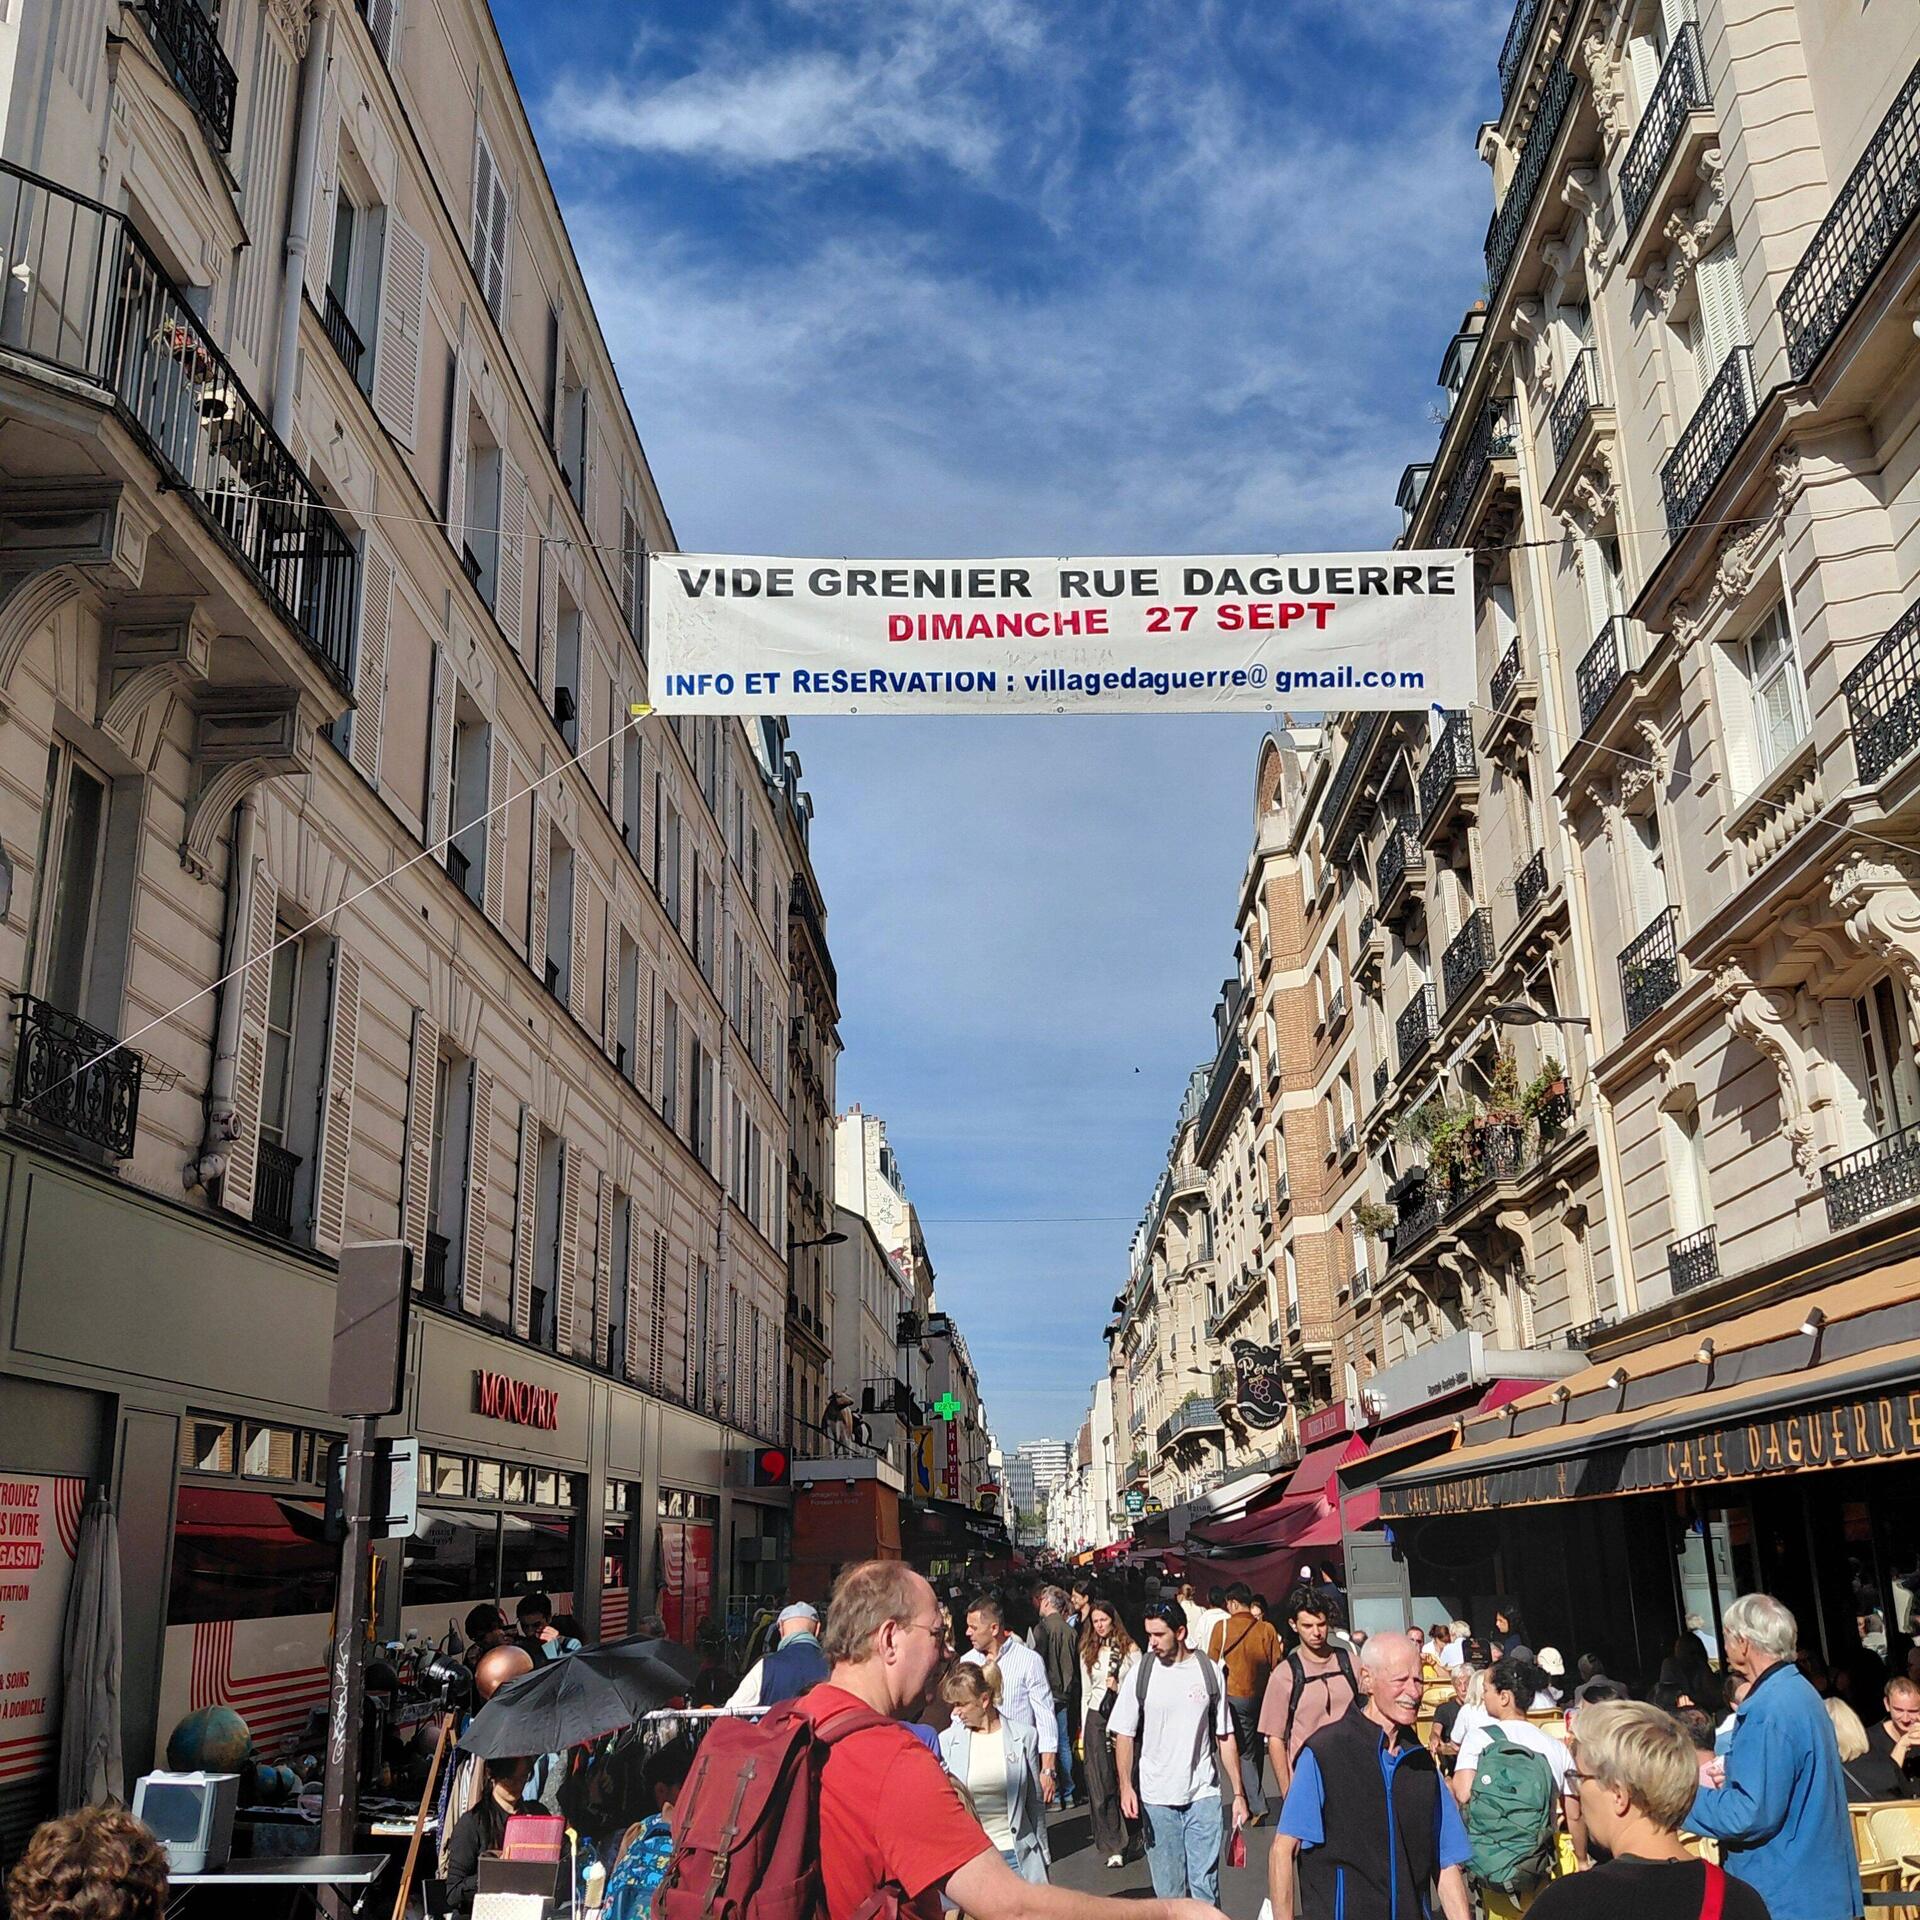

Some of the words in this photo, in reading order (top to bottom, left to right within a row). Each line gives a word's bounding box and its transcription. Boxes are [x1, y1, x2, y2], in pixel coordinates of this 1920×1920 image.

[677, 568, 794, 598] VIDE
[808, 568, 1033, 598] GRENIER
[1059, 568, 1160, 598] RUE
[1183, 566, 1456, 596] DAGUERRE
[888, 608, 1109, 642] DIMANCHE
[1146, 606, 1198, 633] 27
[1217, 602, 1337, 631] SEPT
[666, 673, 734, 696] INFO
[745, 672, 781, 695] ET
[793, 669, 996, 693] RESERVATION
[480, 1368, 560, 1431] MONOPRIX
[1749, 1392, 1920, 1468] DAGUERRE
[947, 1421, 958, 1497] PRIMEUR
[9, 1512, 40, 1536] VOTRE
[6, 1671, 30, 1690] SOINS
[9, 1697, 46, 1718] DOMICILE
